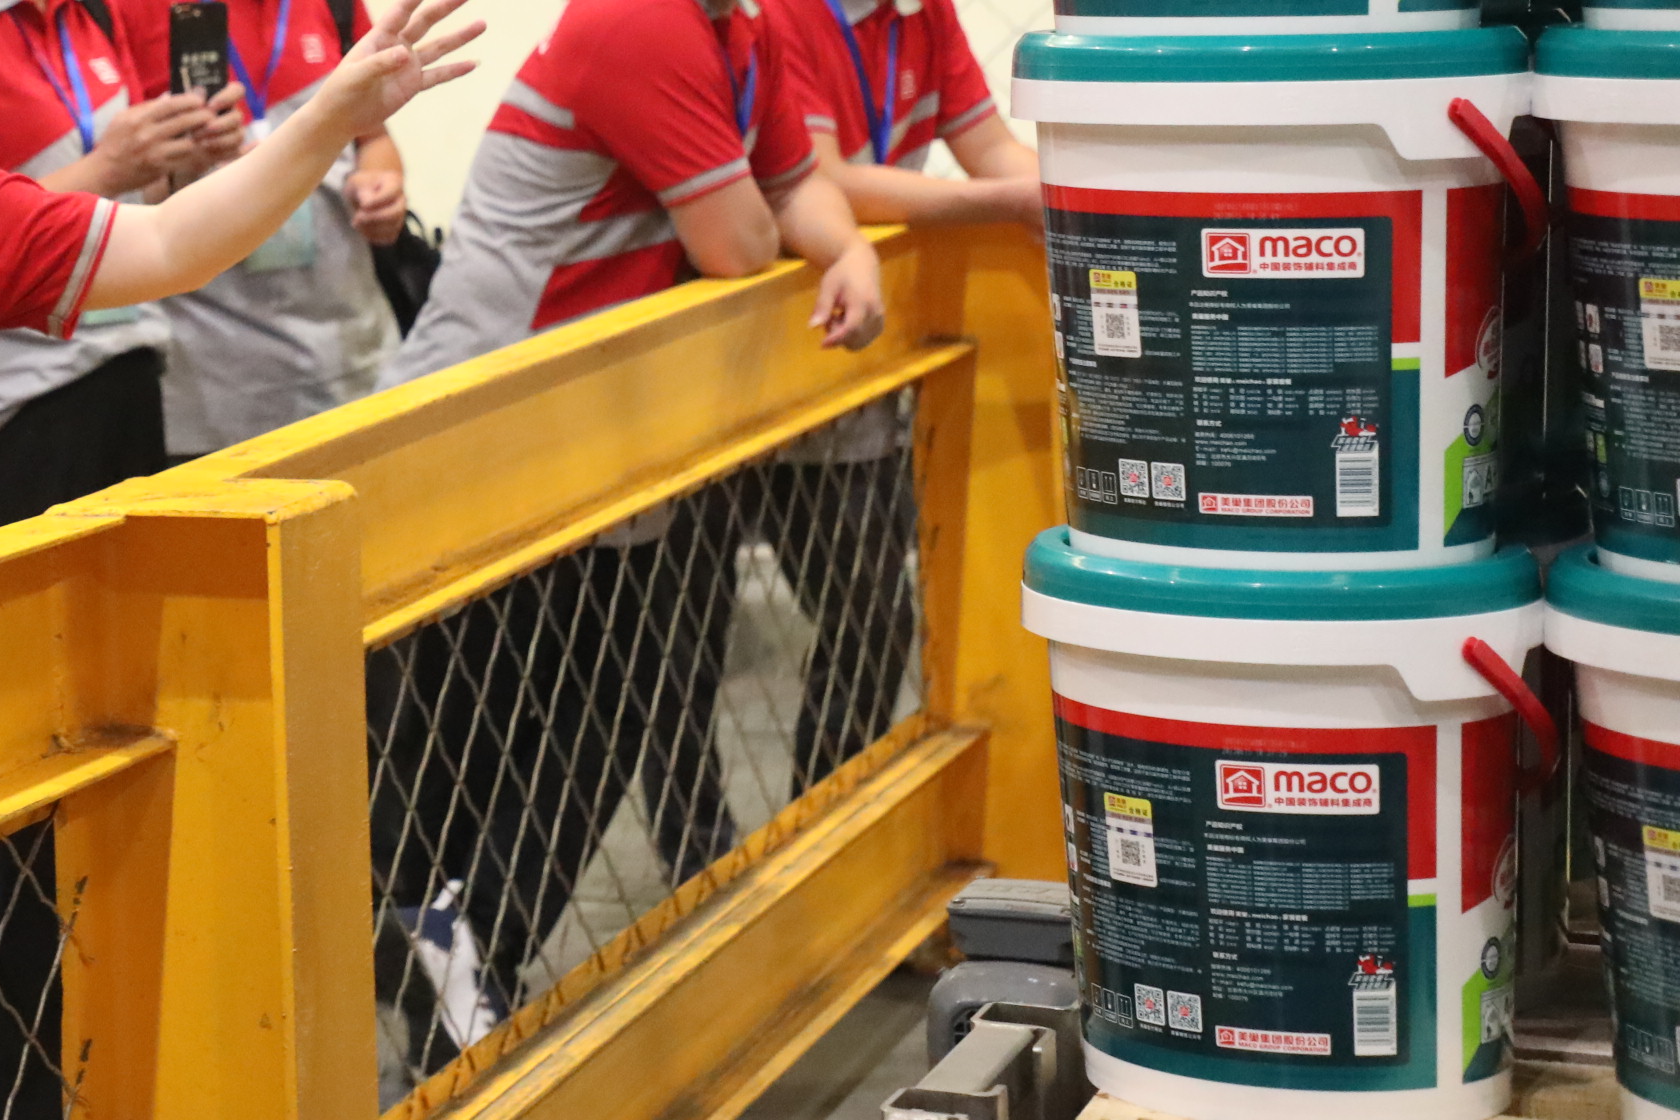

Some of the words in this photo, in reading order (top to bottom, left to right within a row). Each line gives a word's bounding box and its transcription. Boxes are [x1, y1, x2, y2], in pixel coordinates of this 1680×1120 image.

[1259, 235, 1357, 258] maco
[1259, 261, 1358, 272] 中国装饰辅料集成商
[1273, 770, 1373, 794] maco
[1274, 797, 1373, 808] 中国装饰辅料集成商
